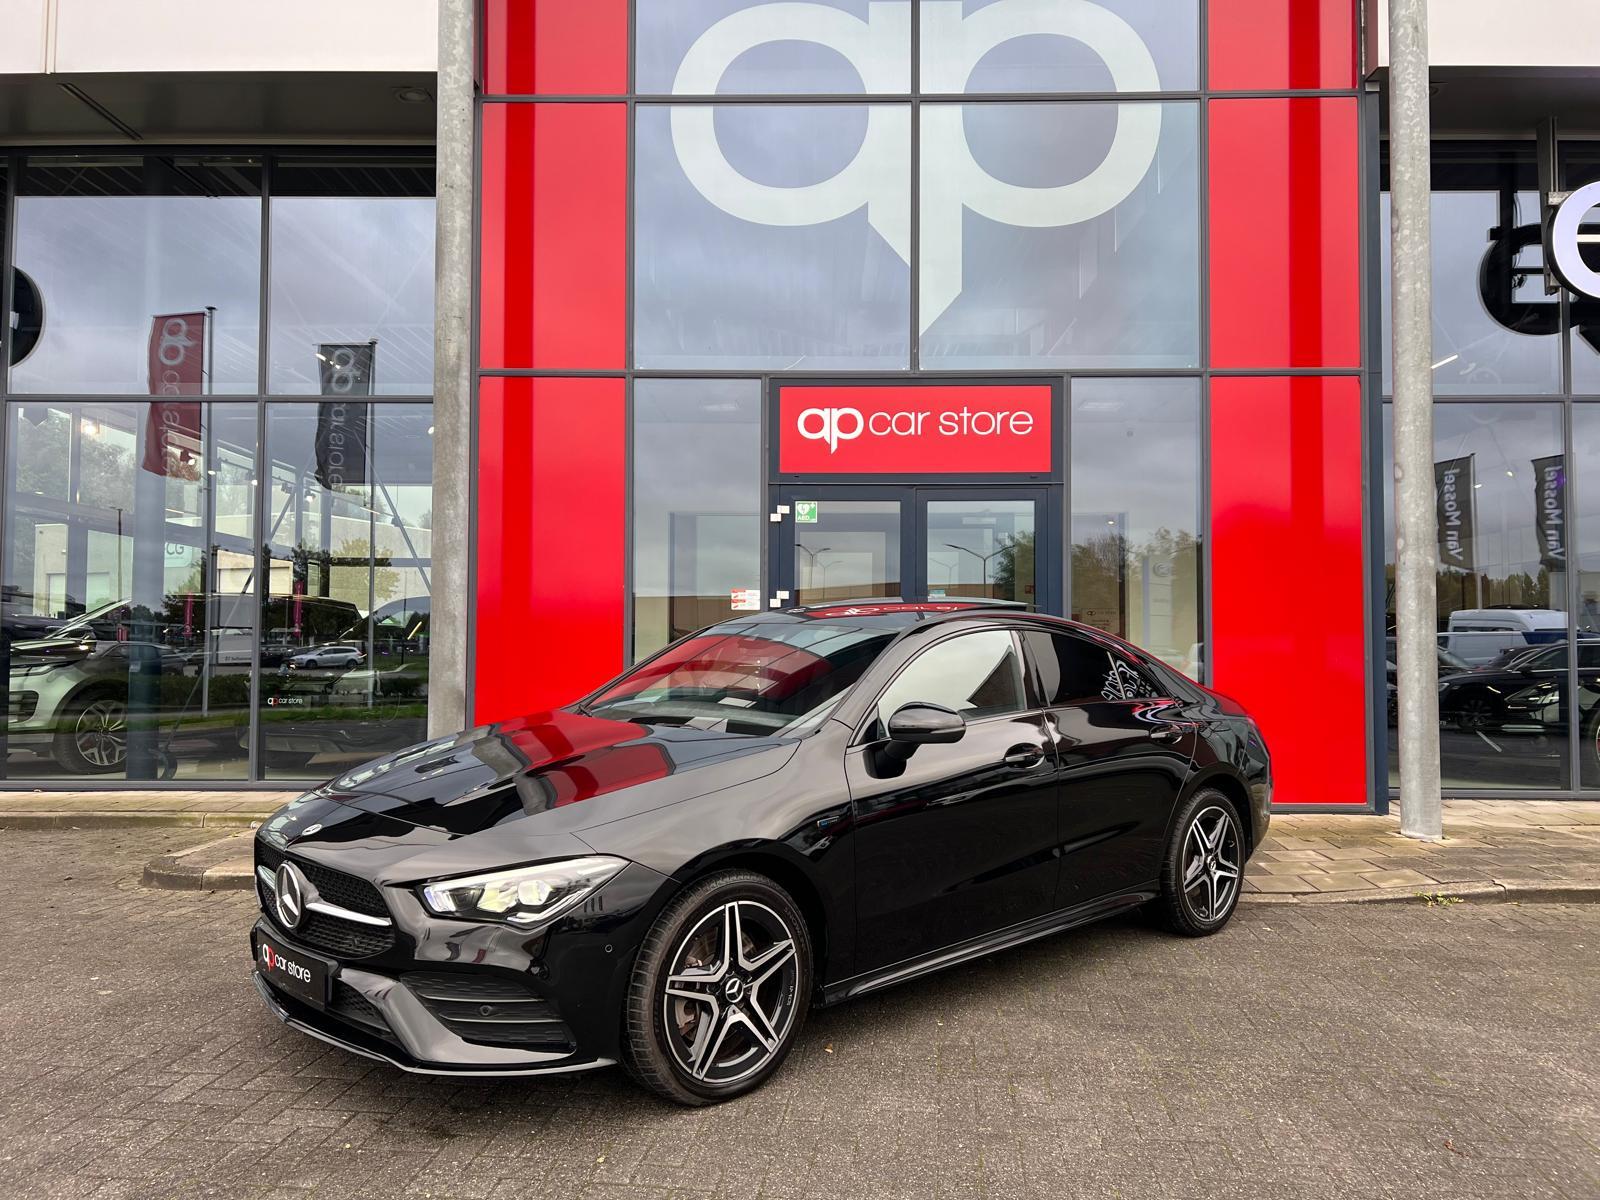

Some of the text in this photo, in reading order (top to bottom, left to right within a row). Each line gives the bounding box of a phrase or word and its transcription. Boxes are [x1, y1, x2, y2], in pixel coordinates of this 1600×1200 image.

[869, 409, 930, 436] car
[938, 405, 1034, 436] store
[275, 954, 287, 971] car
[287, 961, 311, 983] store
